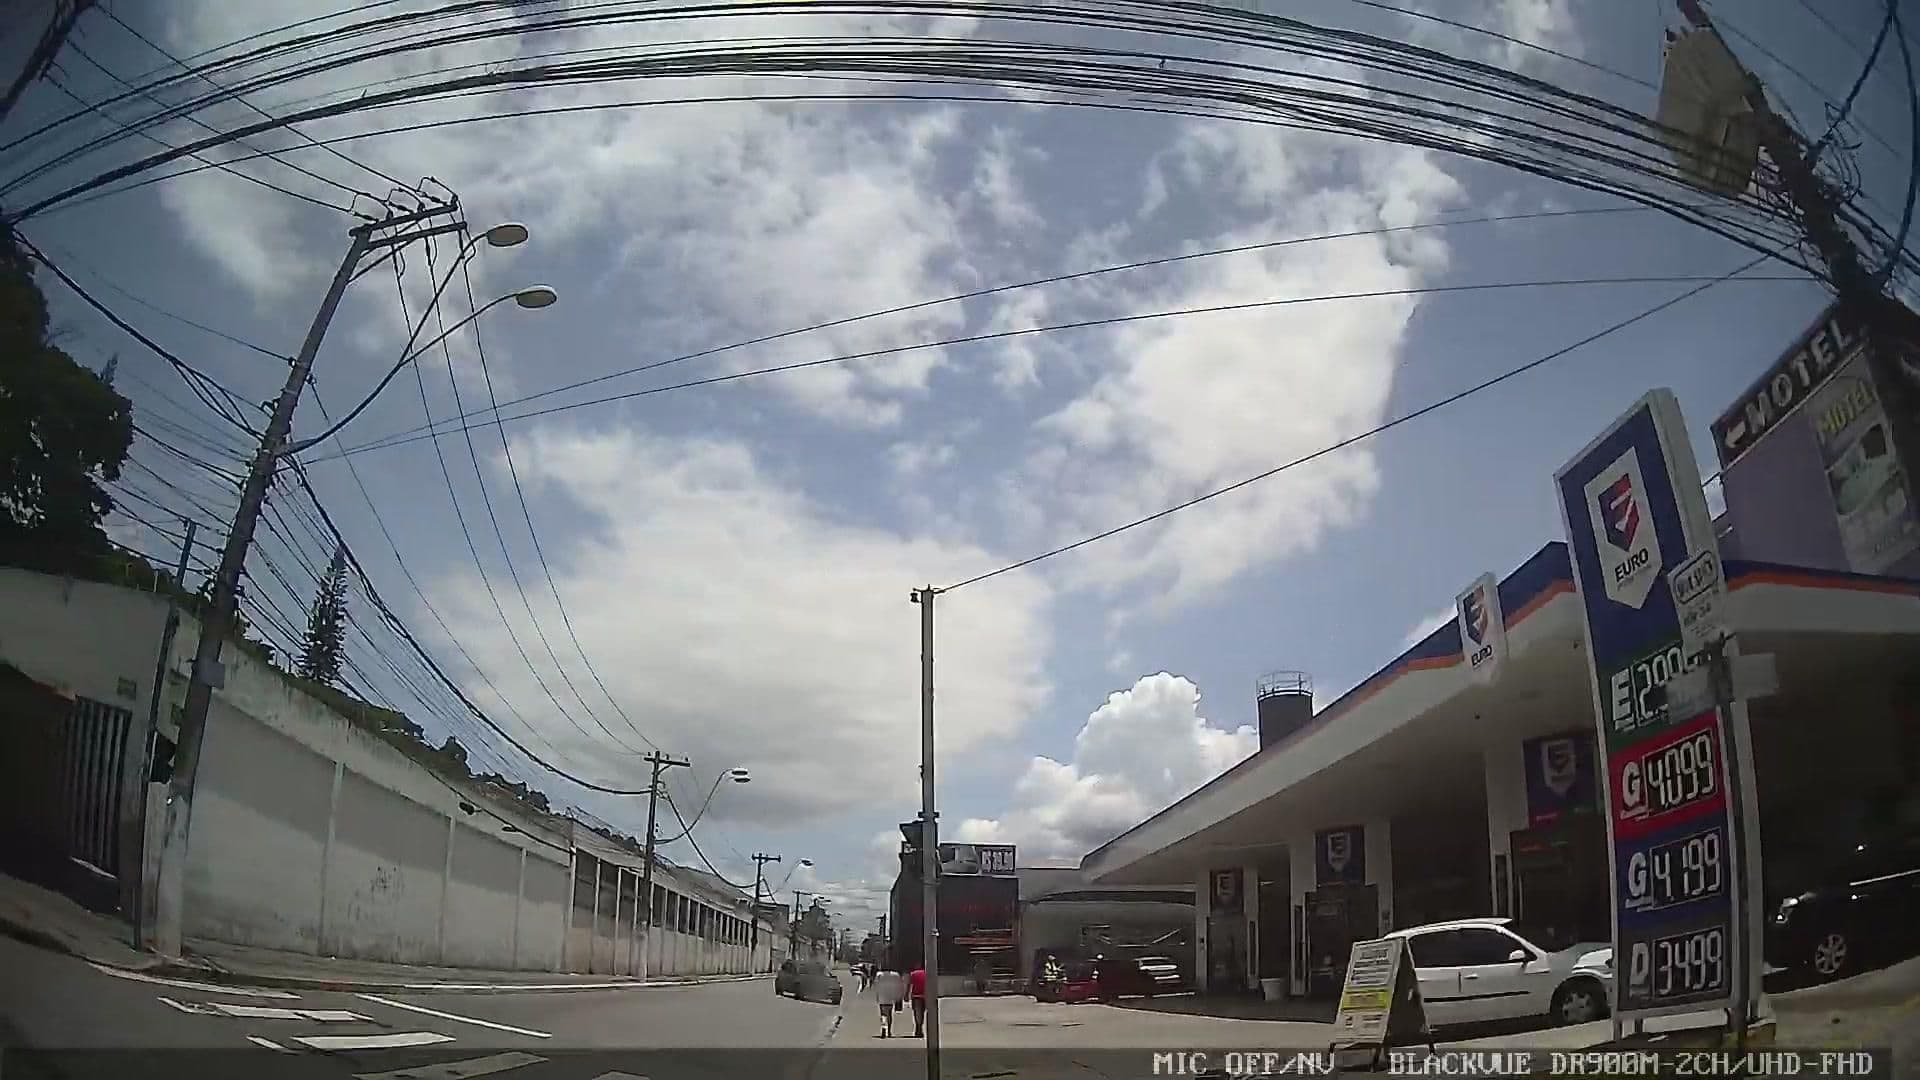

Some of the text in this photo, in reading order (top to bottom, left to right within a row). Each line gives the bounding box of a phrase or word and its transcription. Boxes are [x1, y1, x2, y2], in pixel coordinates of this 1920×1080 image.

[1745, 319, 1853, 430] MOTEL
[1615, 548, 1649, 583] EURO
[1472, 645, 1492, 666] EURO
[1611, 669, 1633, 721] E
[1622, 762, 1641, 807] G
[1628, 852, 1647, 897] G
[1631, 943, 1650, 986] D
